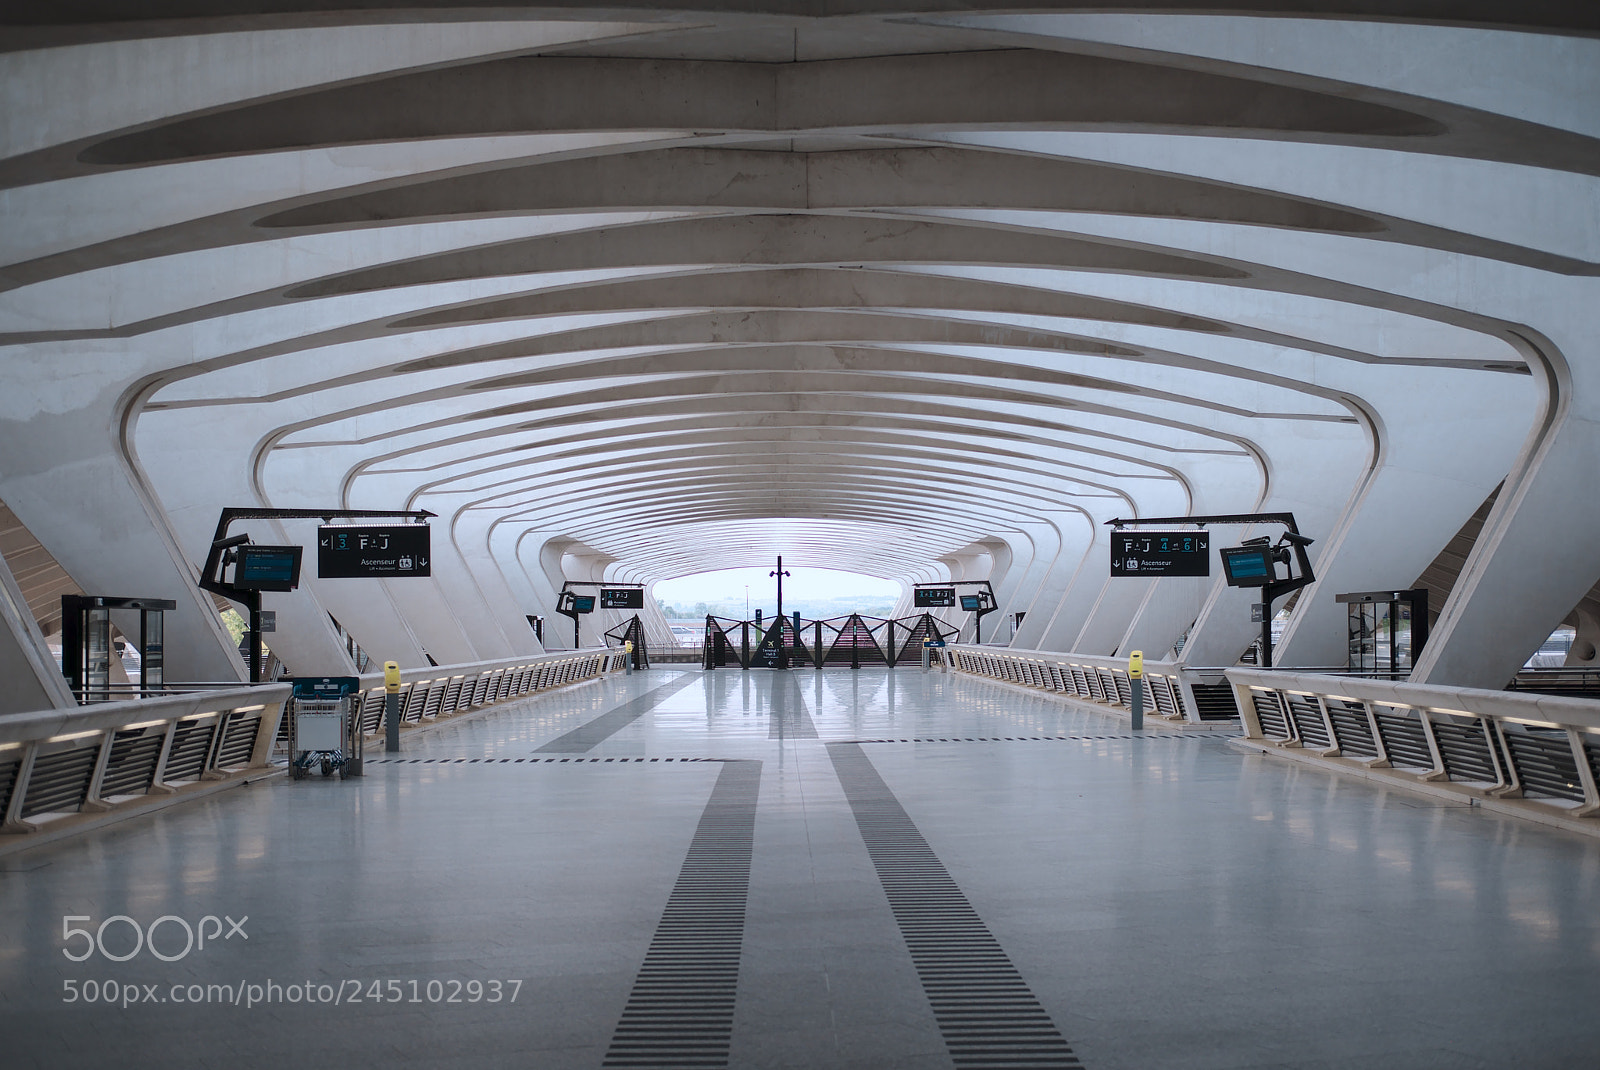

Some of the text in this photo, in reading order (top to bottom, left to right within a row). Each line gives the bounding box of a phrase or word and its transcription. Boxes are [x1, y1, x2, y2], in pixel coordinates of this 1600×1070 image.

[339, 538, 346, 549] 3
[360, 538, 368, 550] F
[380, 538, 389, 550] J
[1125, 542, 1132, 553] F
[1142, 542, 1150, 553] J
[1161, 542, 1167, 551] 4
[1184, 542, 1190, 551] 6
[360, 558, 396, 566] Ascenseur
